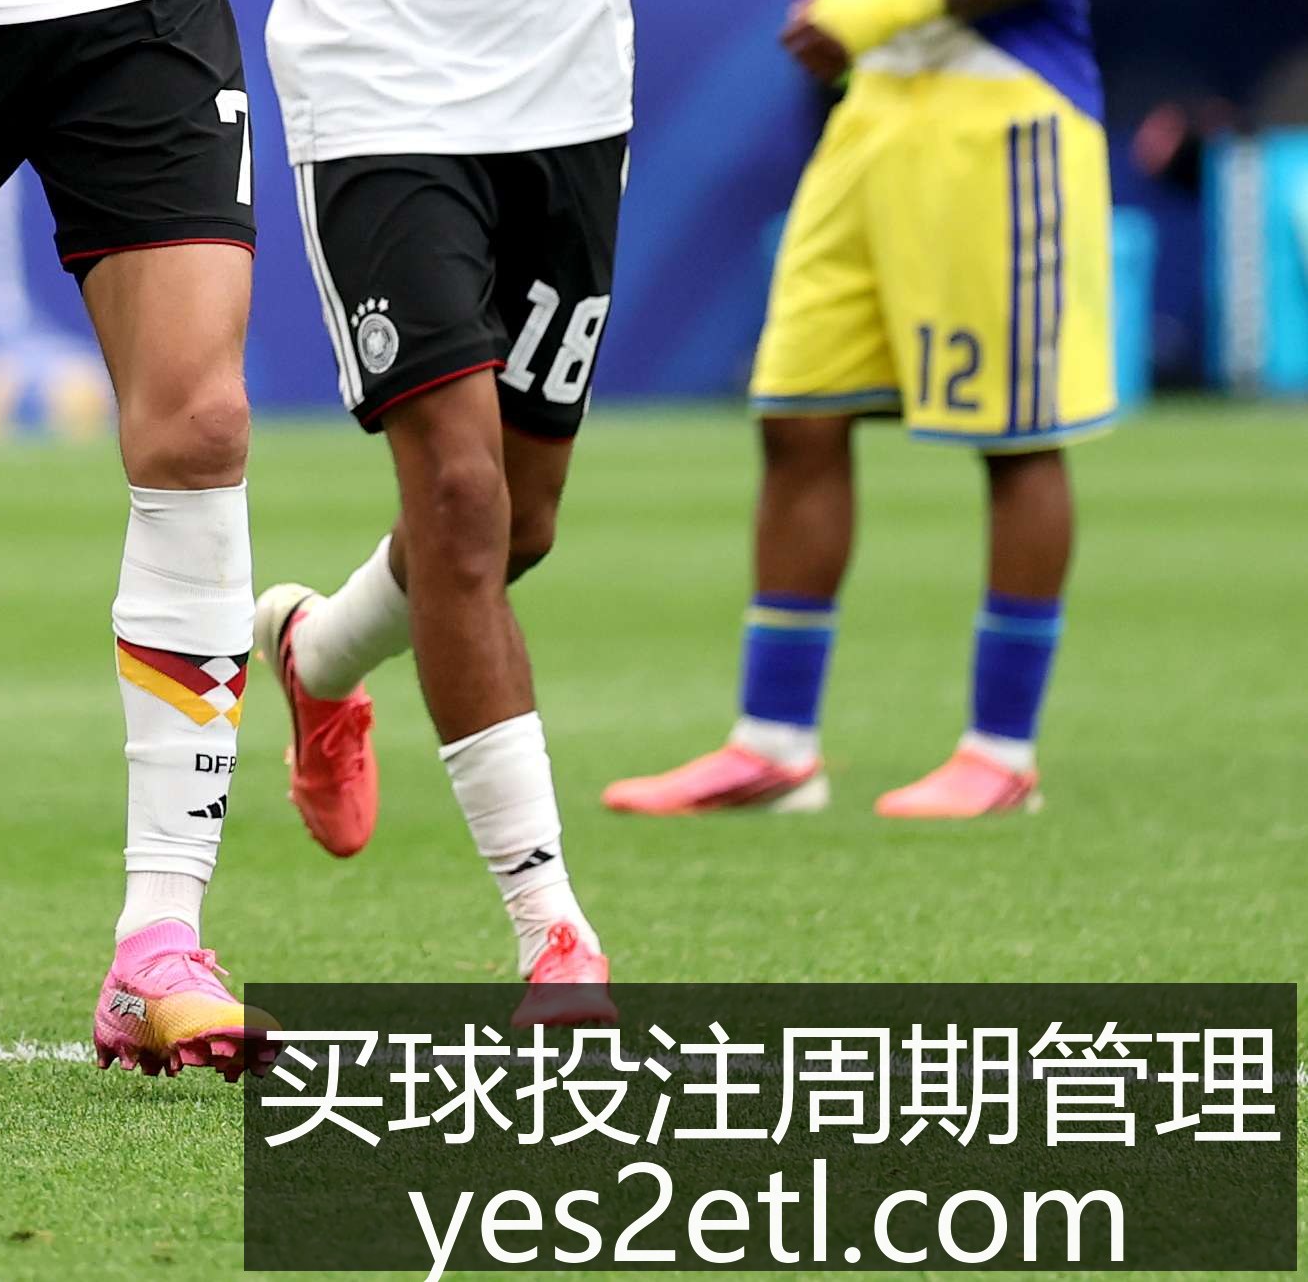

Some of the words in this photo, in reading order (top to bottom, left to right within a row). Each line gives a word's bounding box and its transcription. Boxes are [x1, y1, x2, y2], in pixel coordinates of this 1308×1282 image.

[214, 89, 251, 206] 7
[497, 279, 611, 405] 18
[917, 324, 981, 412] 12
